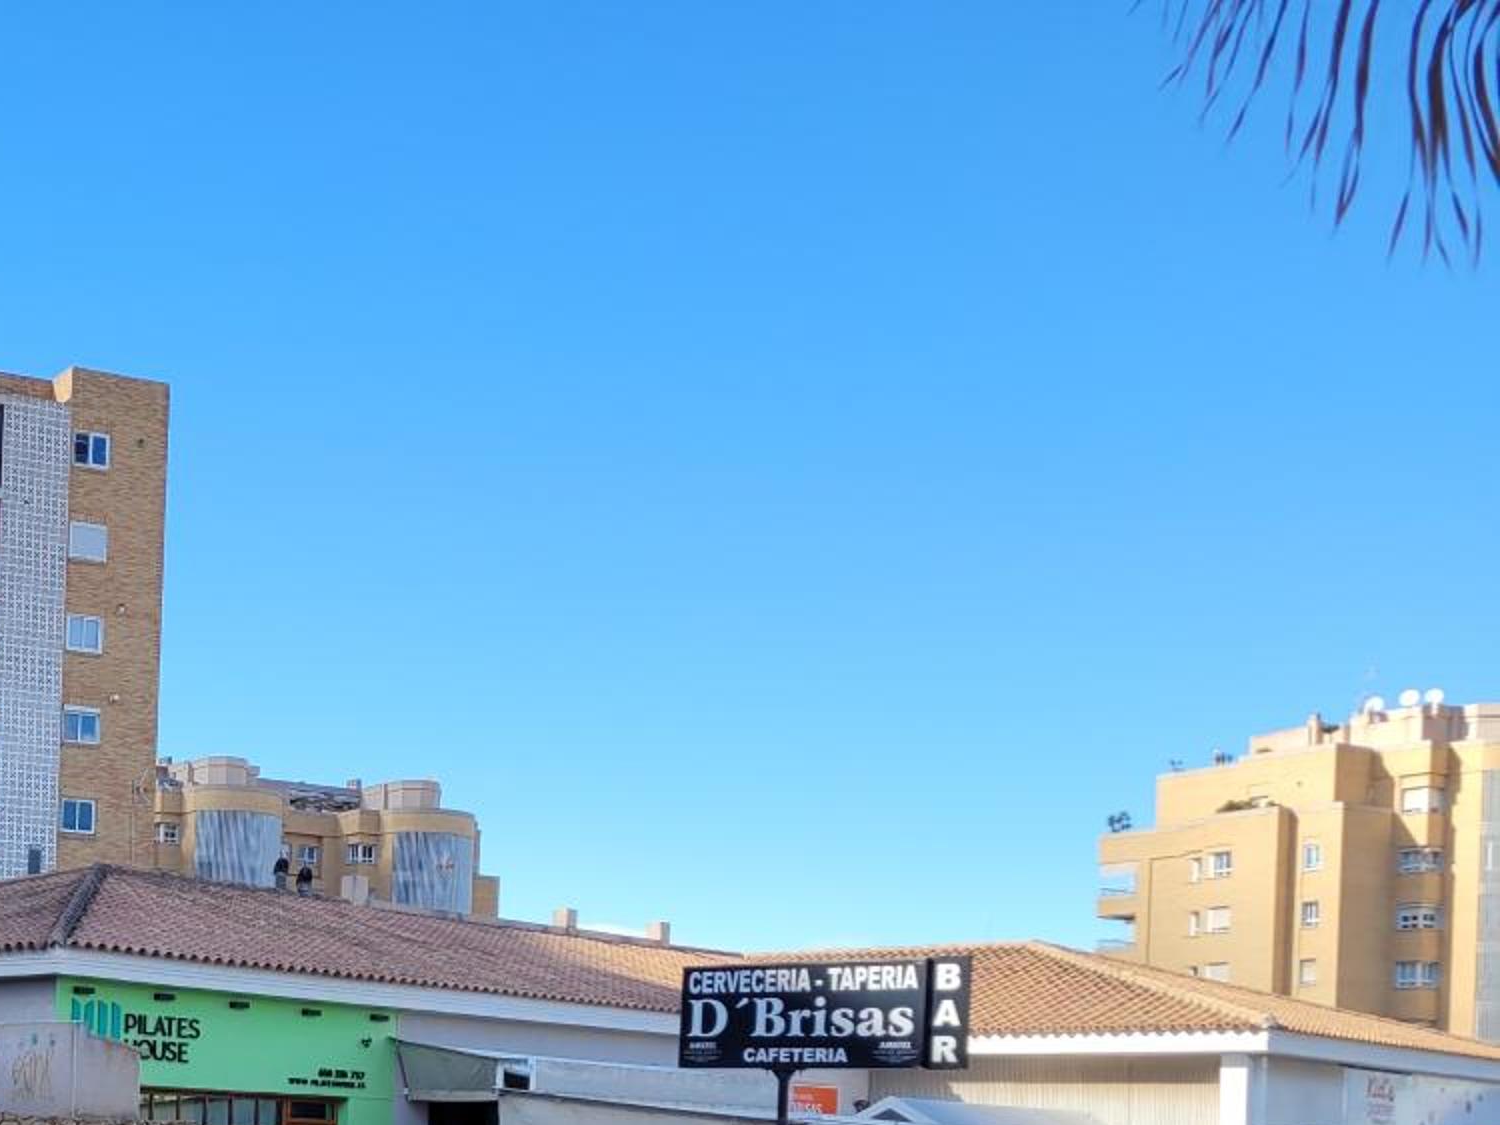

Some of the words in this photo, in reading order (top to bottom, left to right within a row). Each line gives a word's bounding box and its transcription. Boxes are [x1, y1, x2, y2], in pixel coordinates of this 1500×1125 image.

[688, 968, 811, 994] CERVECERIA
[828, 965, 919, 991] TAPERIA
[124, 1013, 200, 1039] PILATES
[124, 1038, 189, 1063] OUSE
[743, 1047, 848, 1063] CAFETERIA
